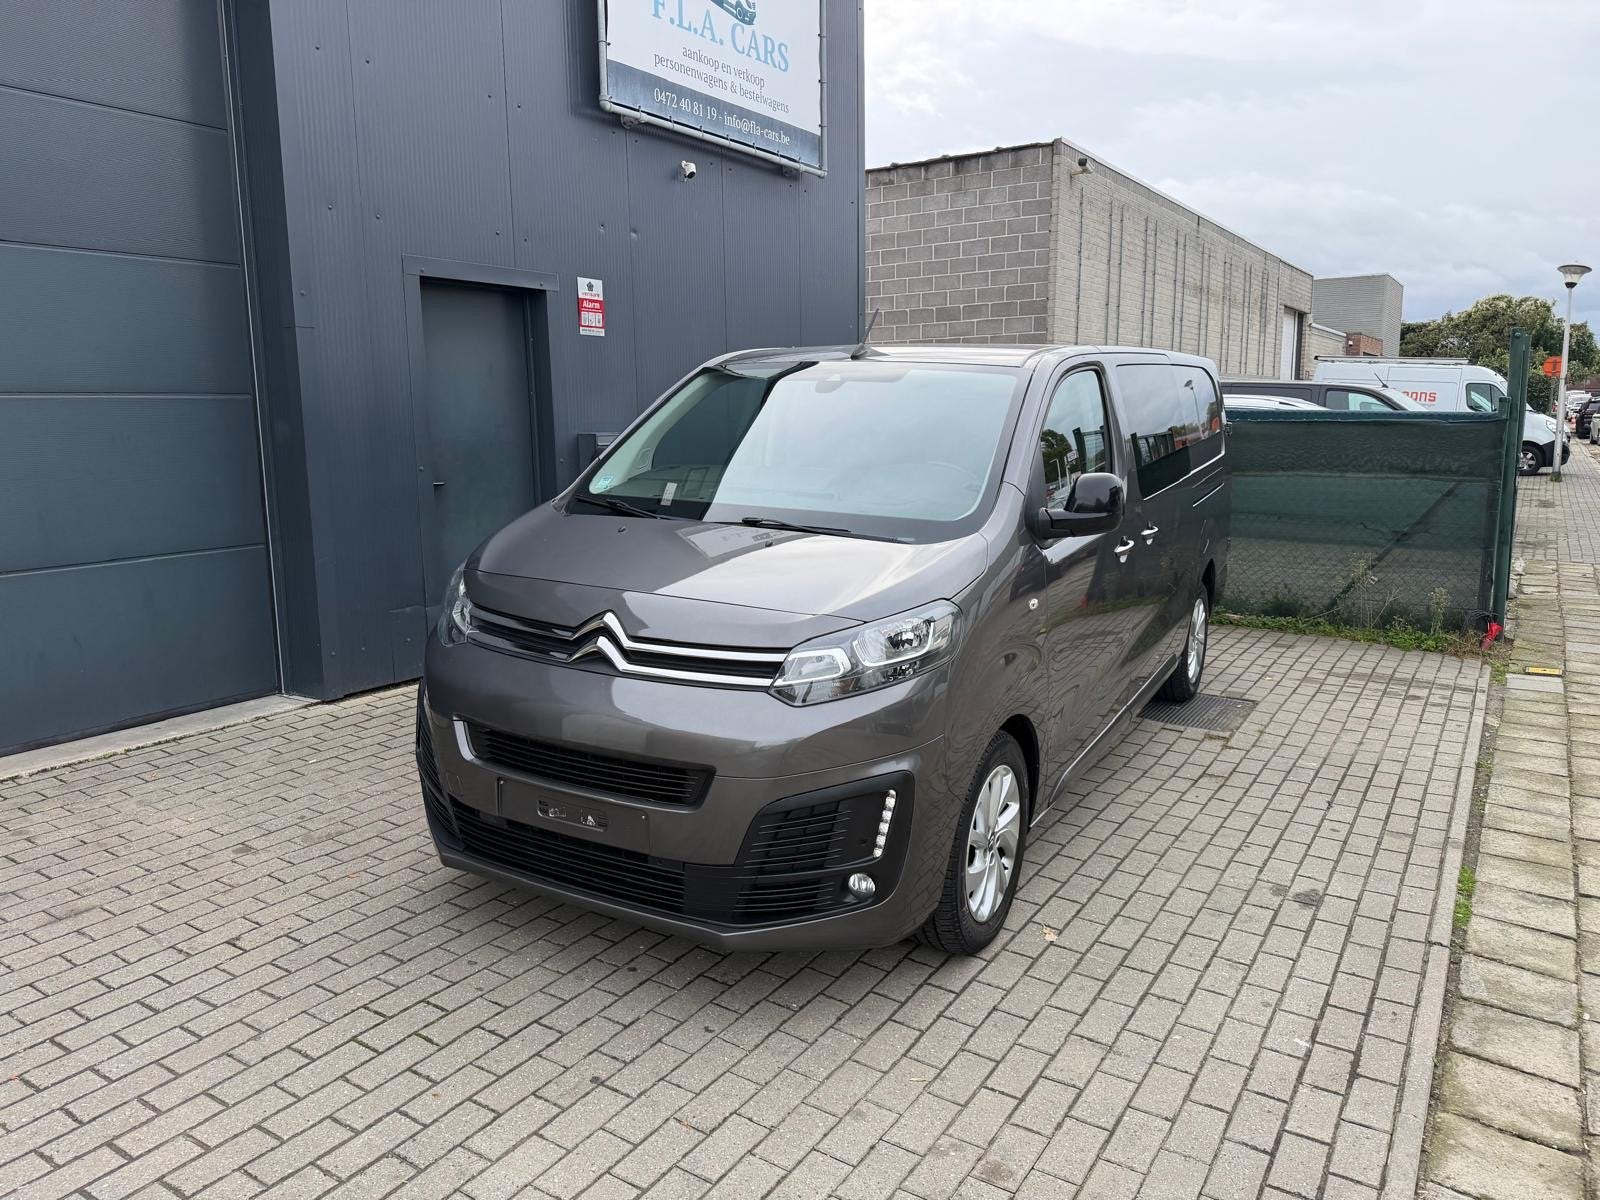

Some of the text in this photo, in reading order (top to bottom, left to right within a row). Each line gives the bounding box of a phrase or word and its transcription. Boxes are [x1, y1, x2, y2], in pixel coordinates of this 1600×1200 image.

[682, 46, 765, 91] aankoop en verkoop
[730, 22, 789, 73] CARS
[654, 53, 790, 114] personenwagens & bestelwagens
[654, 87, 678, 108] 0472
[679, 97, 691, 112] 40
[693, 101, 703, 117] 81
[706, 106, 717, 121] 19
[724, 111, 791, 145] info@fla-cars.be
[582, 299, 601, 310] Alarm
